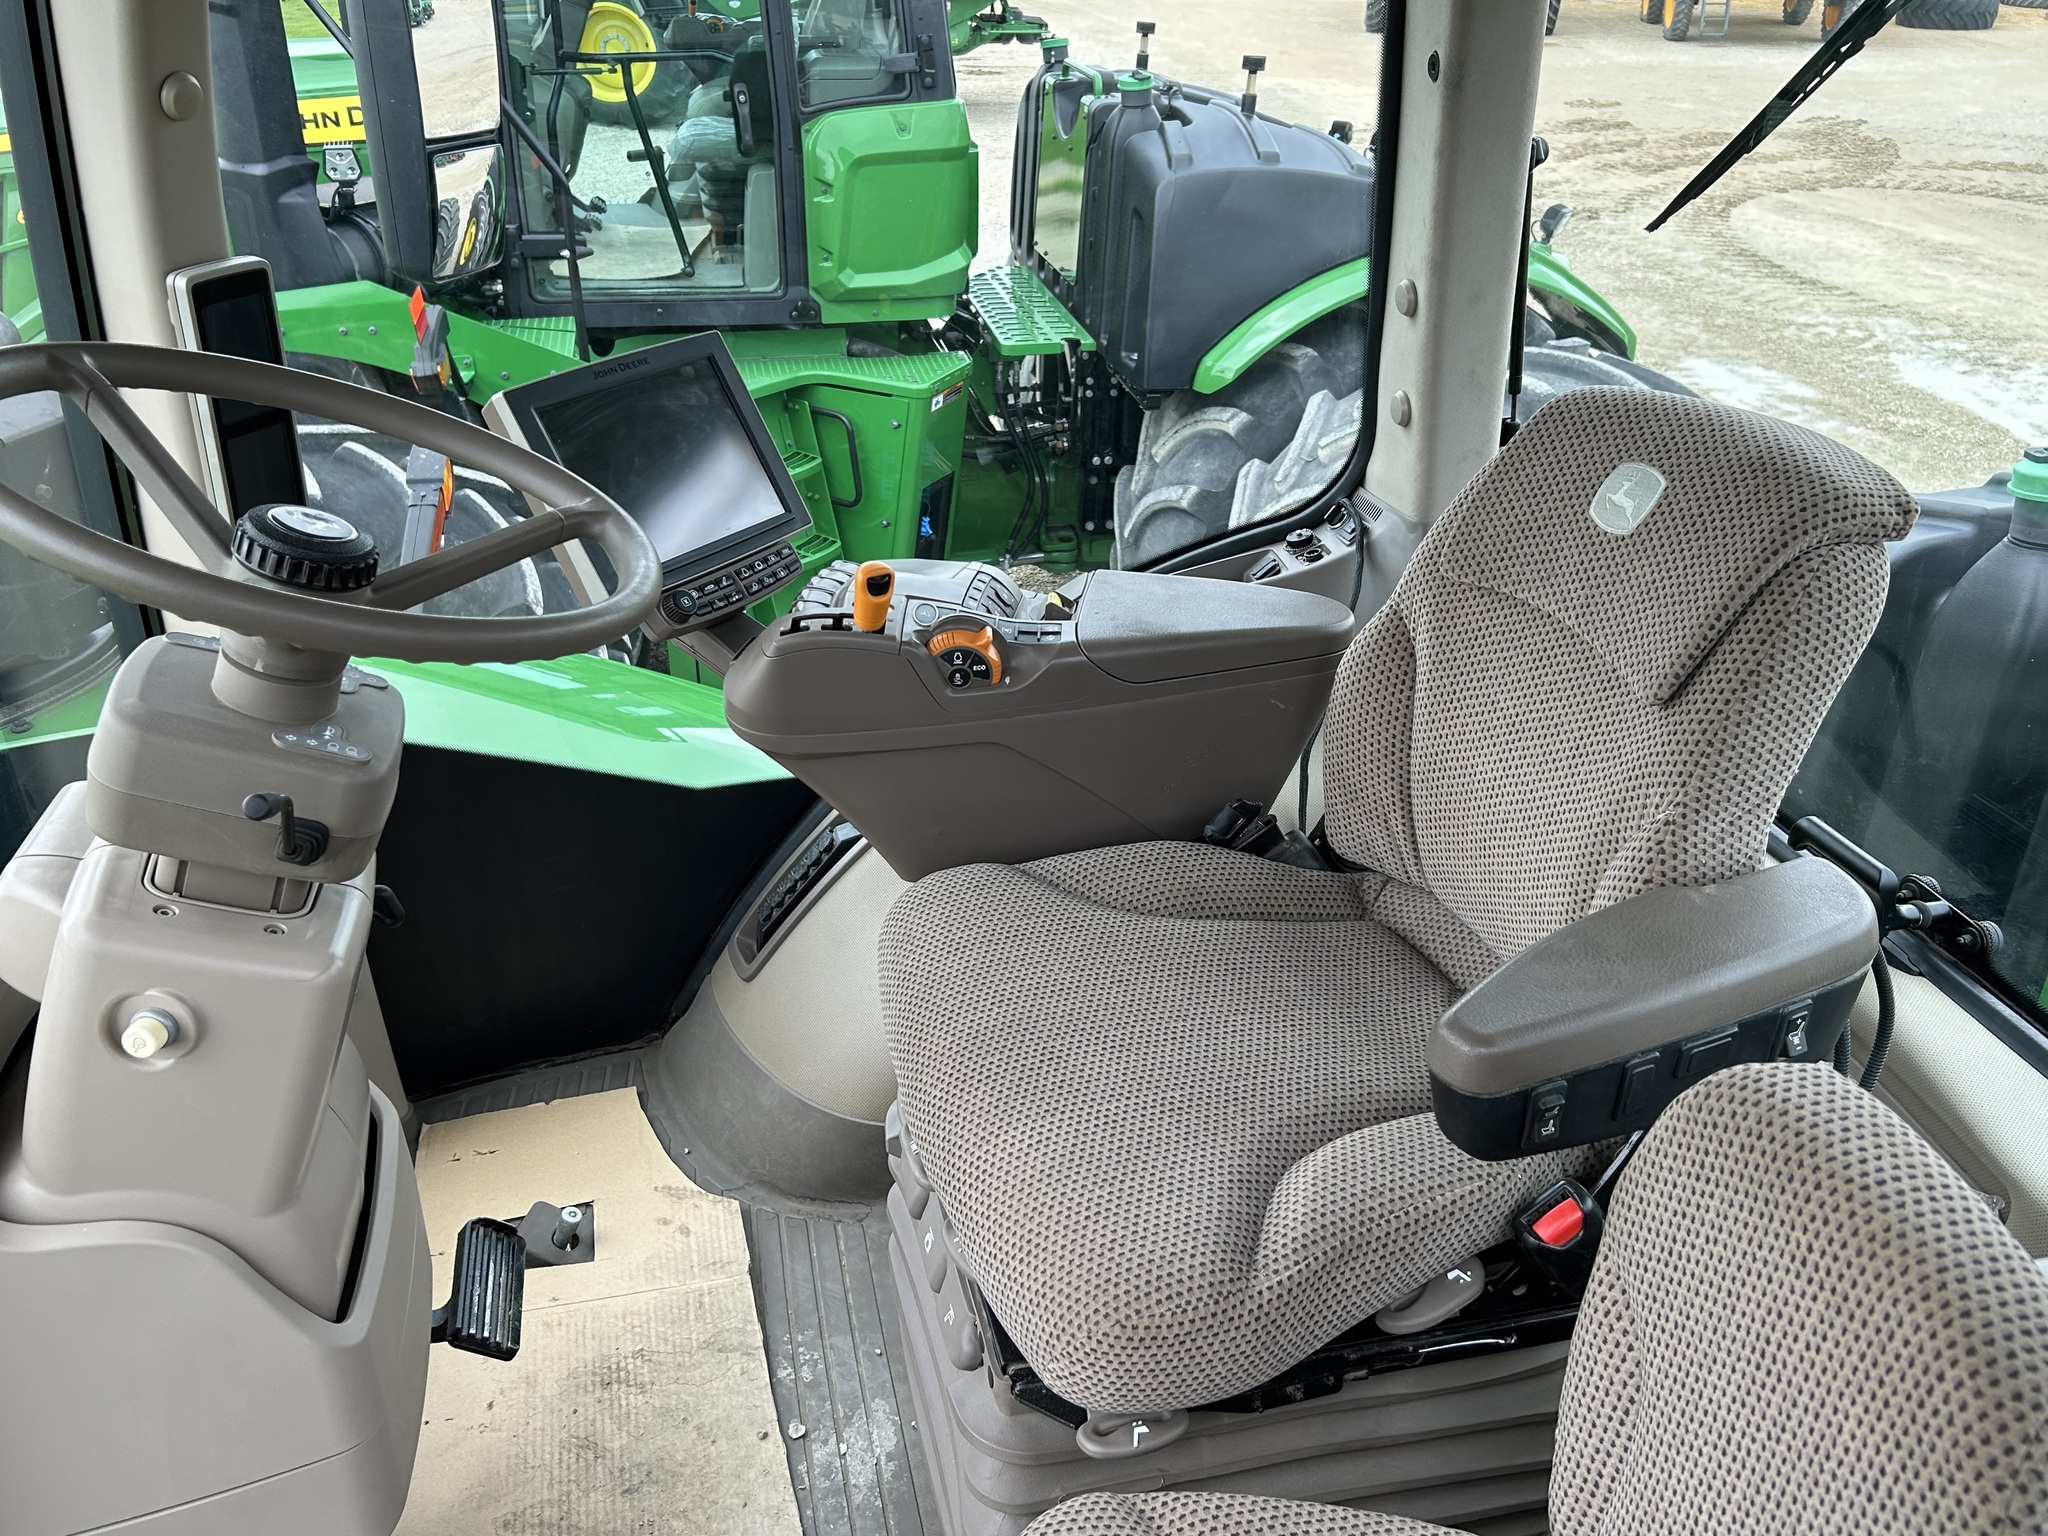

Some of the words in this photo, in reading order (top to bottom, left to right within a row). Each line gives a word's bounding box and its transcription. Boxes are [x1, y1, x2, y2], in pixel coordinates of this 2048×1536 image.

[299, 111, 341, 129] HN
[593, 366, 618, 380] JOHN
[618, 357, 650, 372] DEERE
